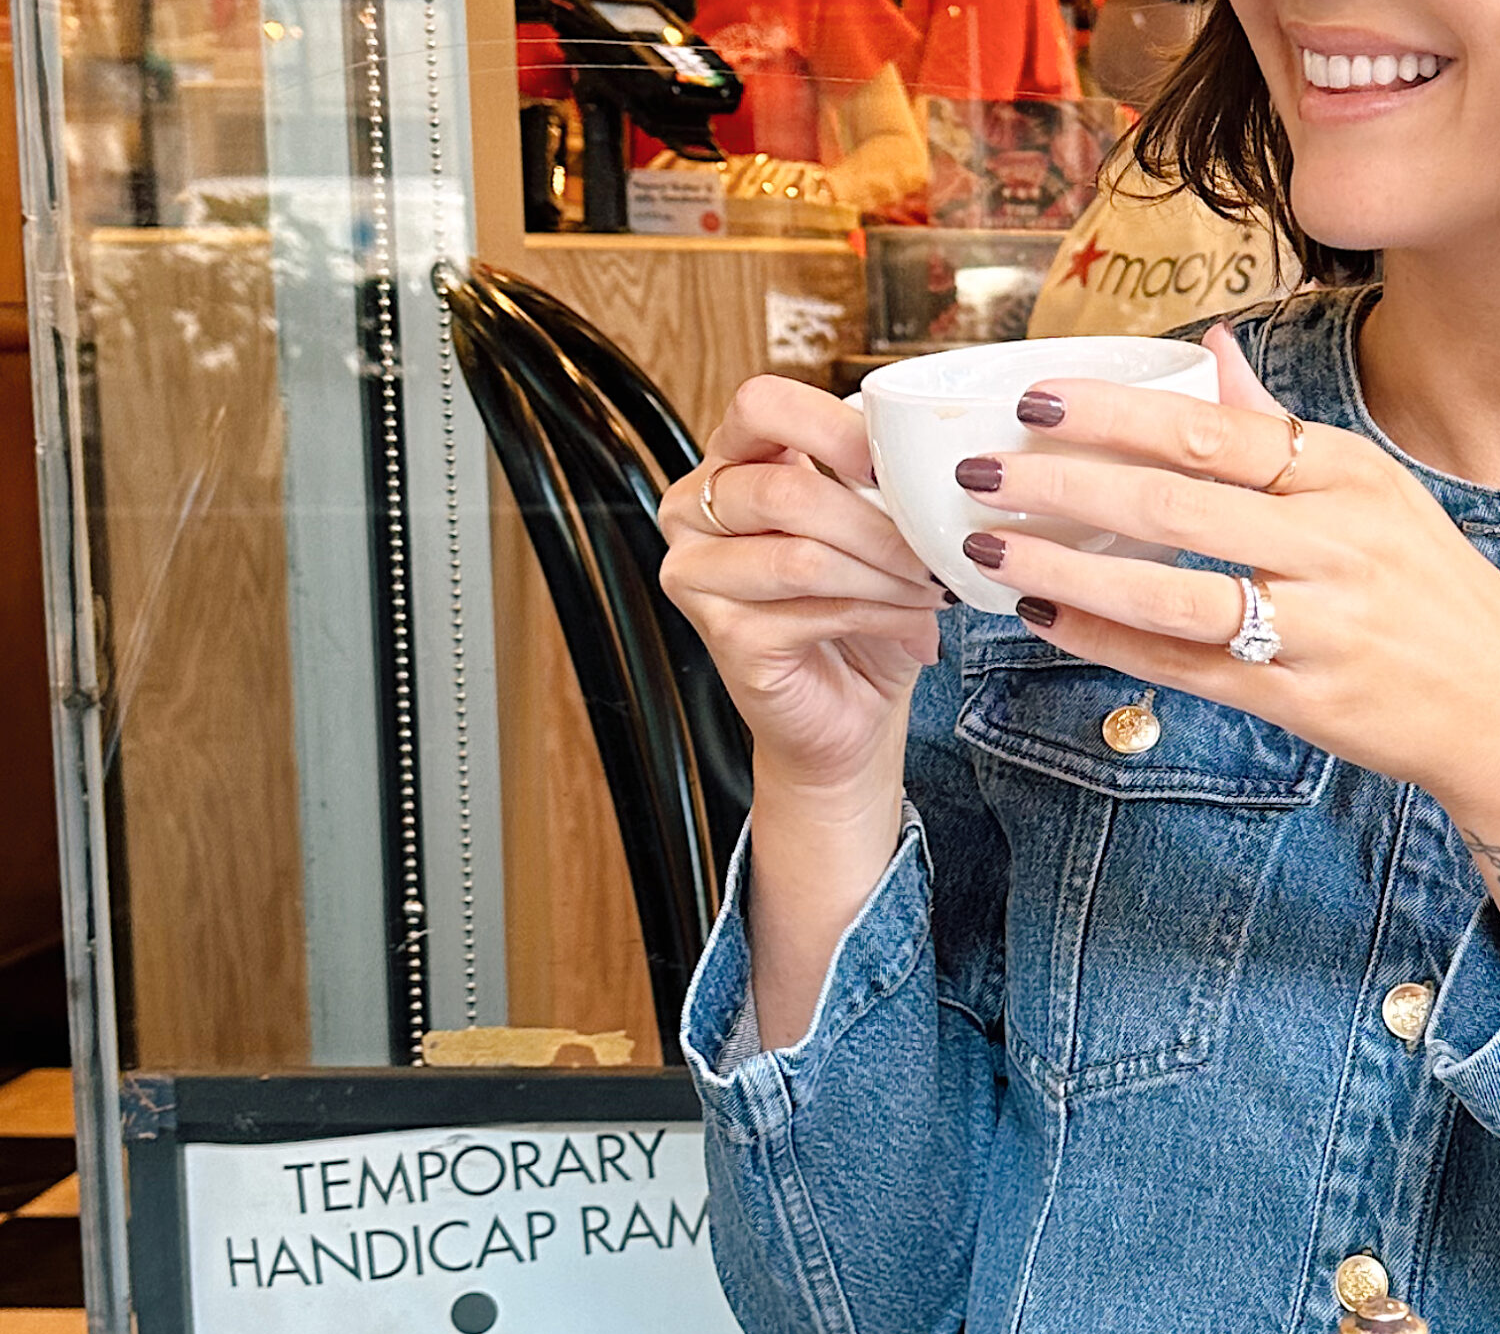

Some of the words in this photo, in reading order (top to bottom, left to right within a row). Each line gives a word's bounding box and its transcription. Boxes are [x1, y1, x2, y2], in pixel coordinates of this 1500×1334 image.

[284, 1129, 667, 1215] TEMPORARY
[226, 1212, 556, 1288] HANDICAP
[581, 1195, 708, 1255] RAM
